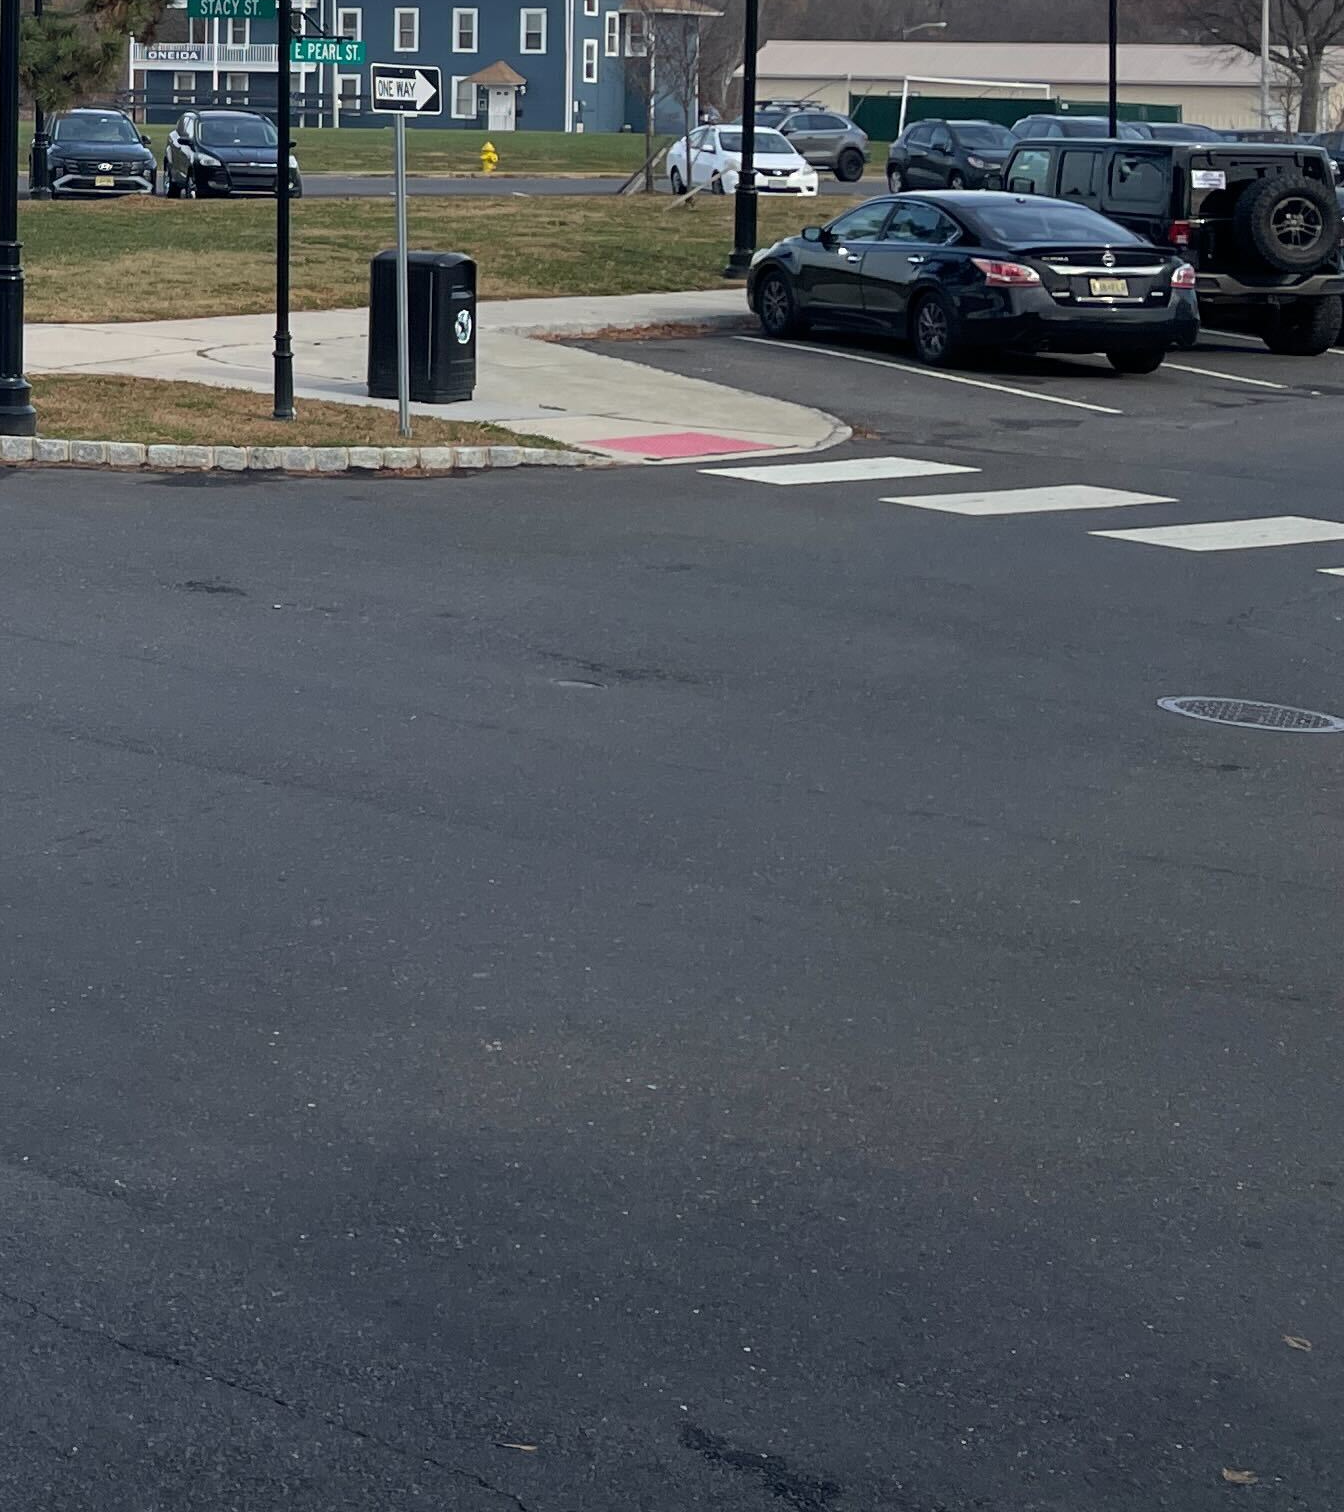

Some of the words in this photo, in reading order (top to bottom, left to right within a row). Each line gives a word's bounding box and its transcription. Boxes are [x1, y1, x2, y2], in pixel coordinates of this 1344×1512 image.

[148, 51, 198, 60] ONEIDA
[295, 42, 304, 59] E
[308, 42, 343, 60] PEARL
[345, 44, 361, 61] ST.
[378, 79, 393, 97] ONE
[396, 80, 416, 97] WAY
